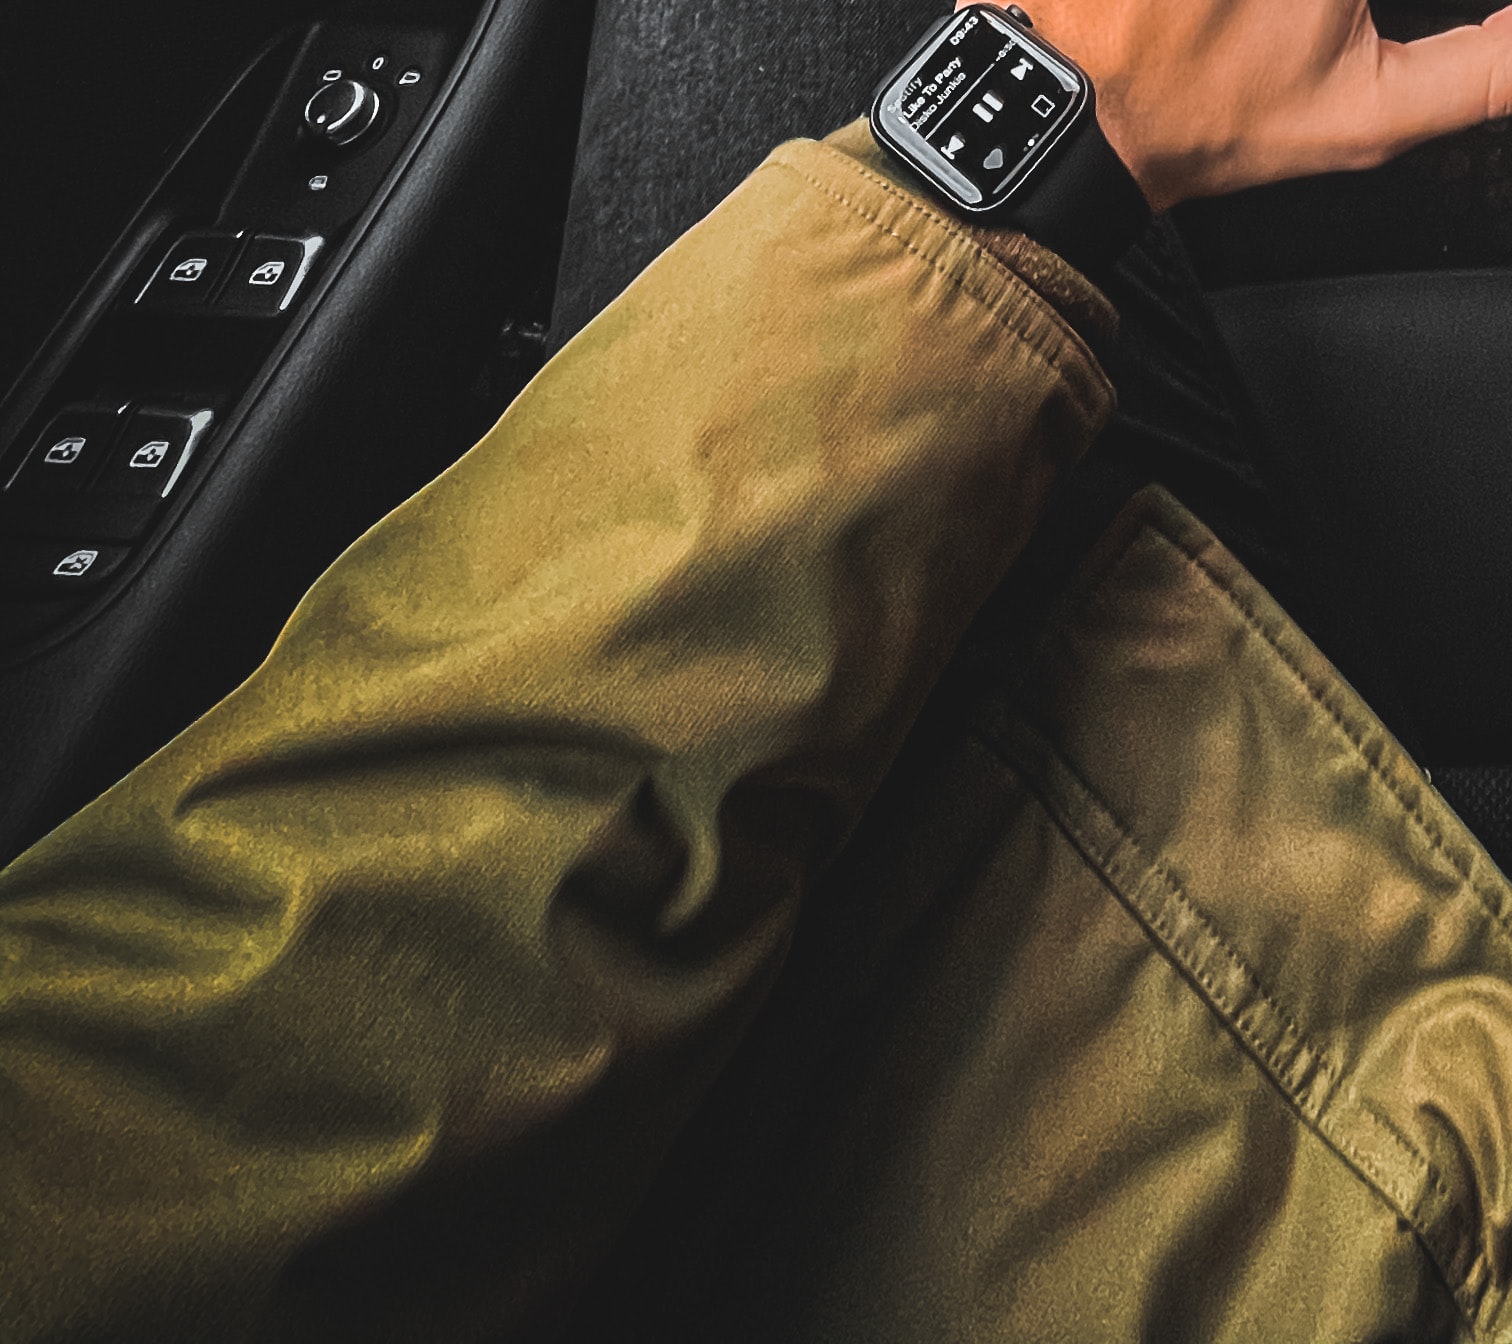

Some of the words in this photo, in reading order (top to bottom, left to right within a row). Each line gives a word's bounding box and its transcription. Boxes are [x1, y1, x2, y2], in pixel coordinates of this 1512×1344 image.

[949, 15, 979, 46] 09:43
[903, 96, 926, 119] Like
[921, 83, 938, 97] To
[934, 56, 962, 85] Party
[909, 104, 938, 132] Disko
[936, 72, 967, 105] Junkie
